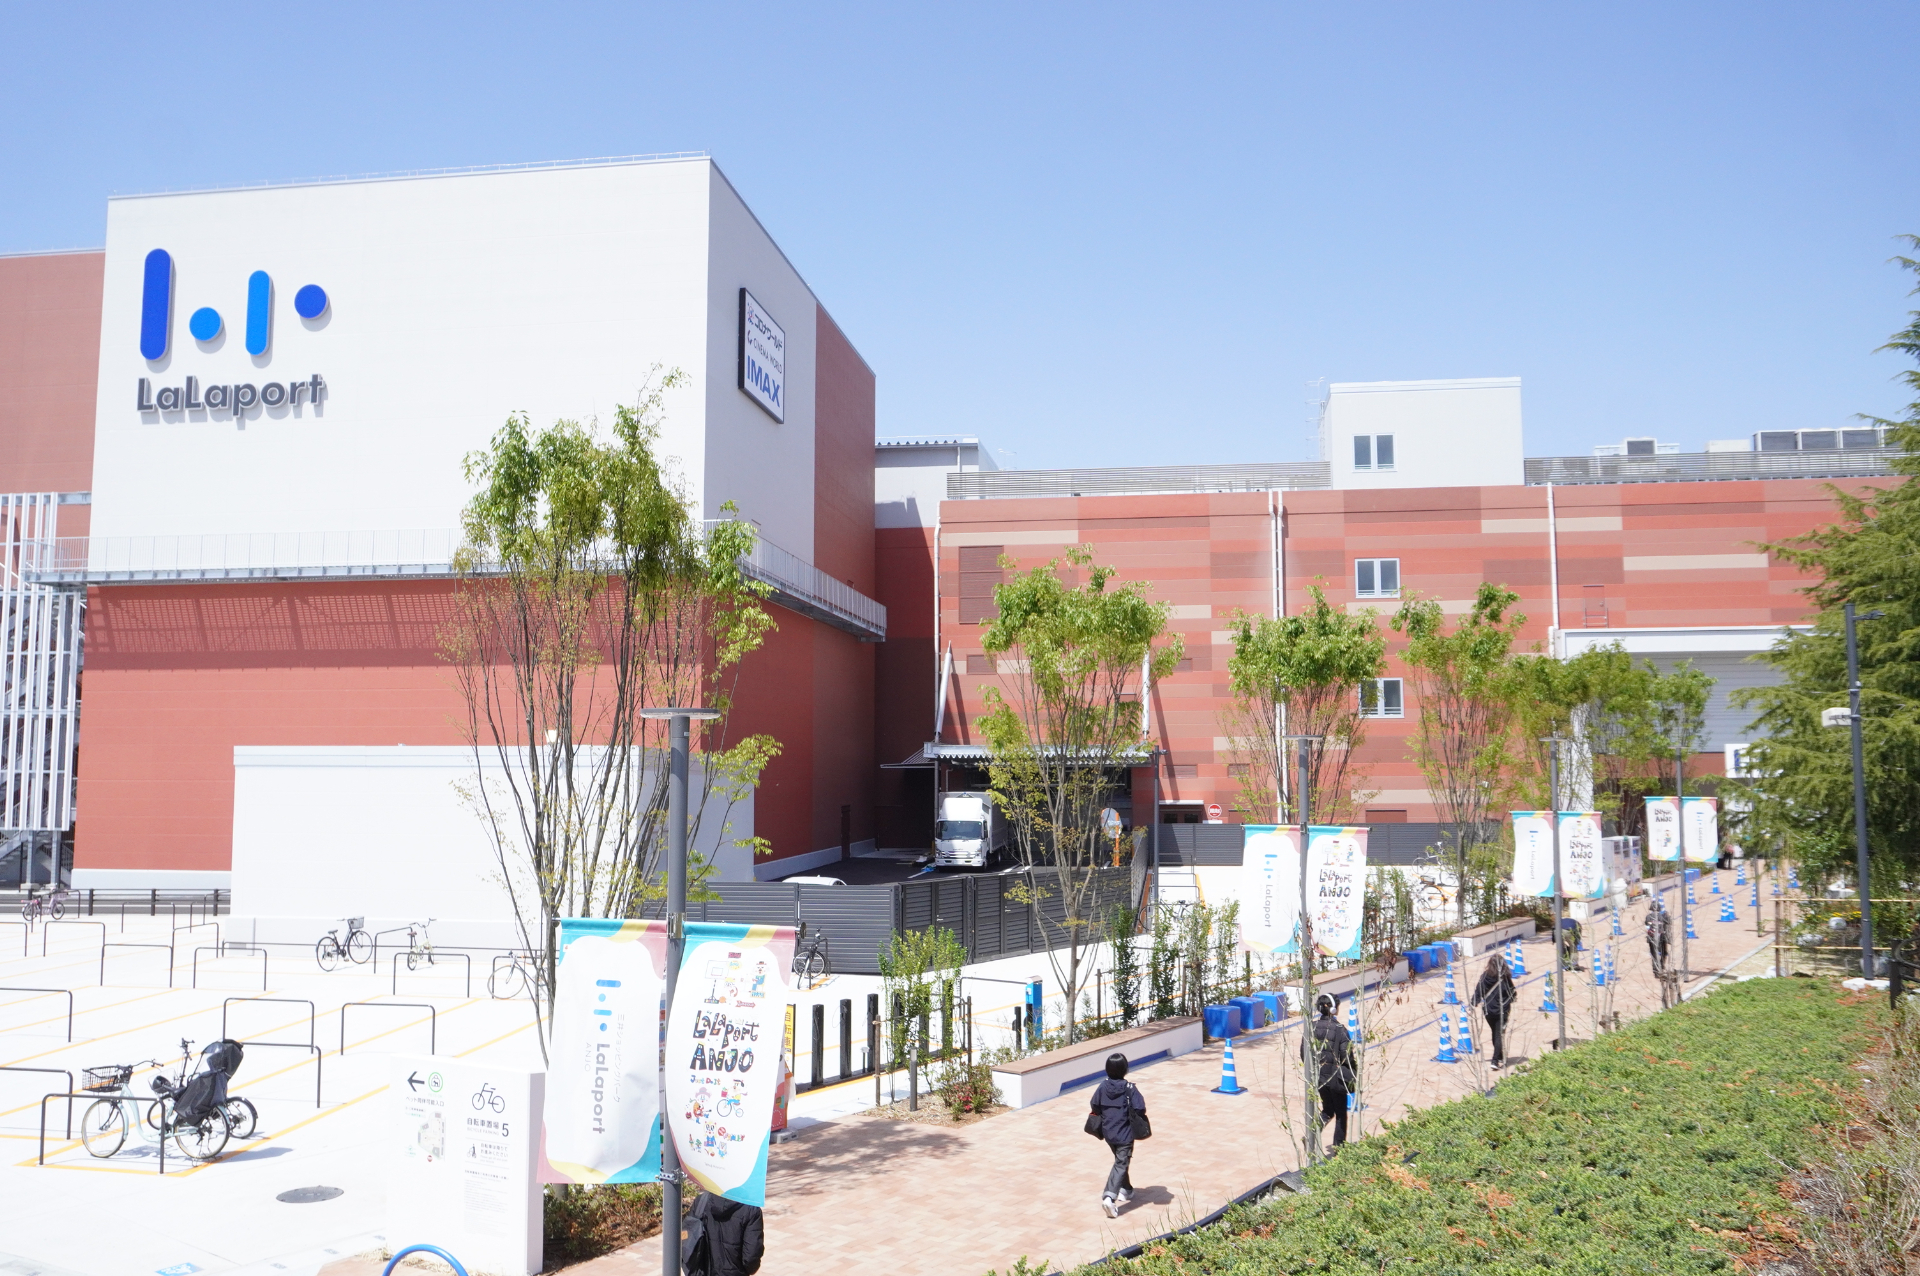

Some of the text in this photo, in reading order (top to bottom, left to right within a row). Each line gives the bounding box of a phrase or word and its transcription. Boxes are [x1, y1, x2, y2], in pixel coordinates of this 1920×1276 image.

[754, 313, 783, 351] コロナワールド
[753, 337, 783, 374] CINEMA WORLD
[136, 373, 324, 417] LaLaport
[747, 354, 781, 408] IMAX
[1263, 884, 1273, 928] LaLaport
[1319, 885, 1351, 898] ANJO
[584, 1042, 592, 1072] ANJO
[689, 1042, 754, 1073] ANJO
[591, 1043, 610, 1134] LaLaport
[502, 1123, 509, 1137] 5
